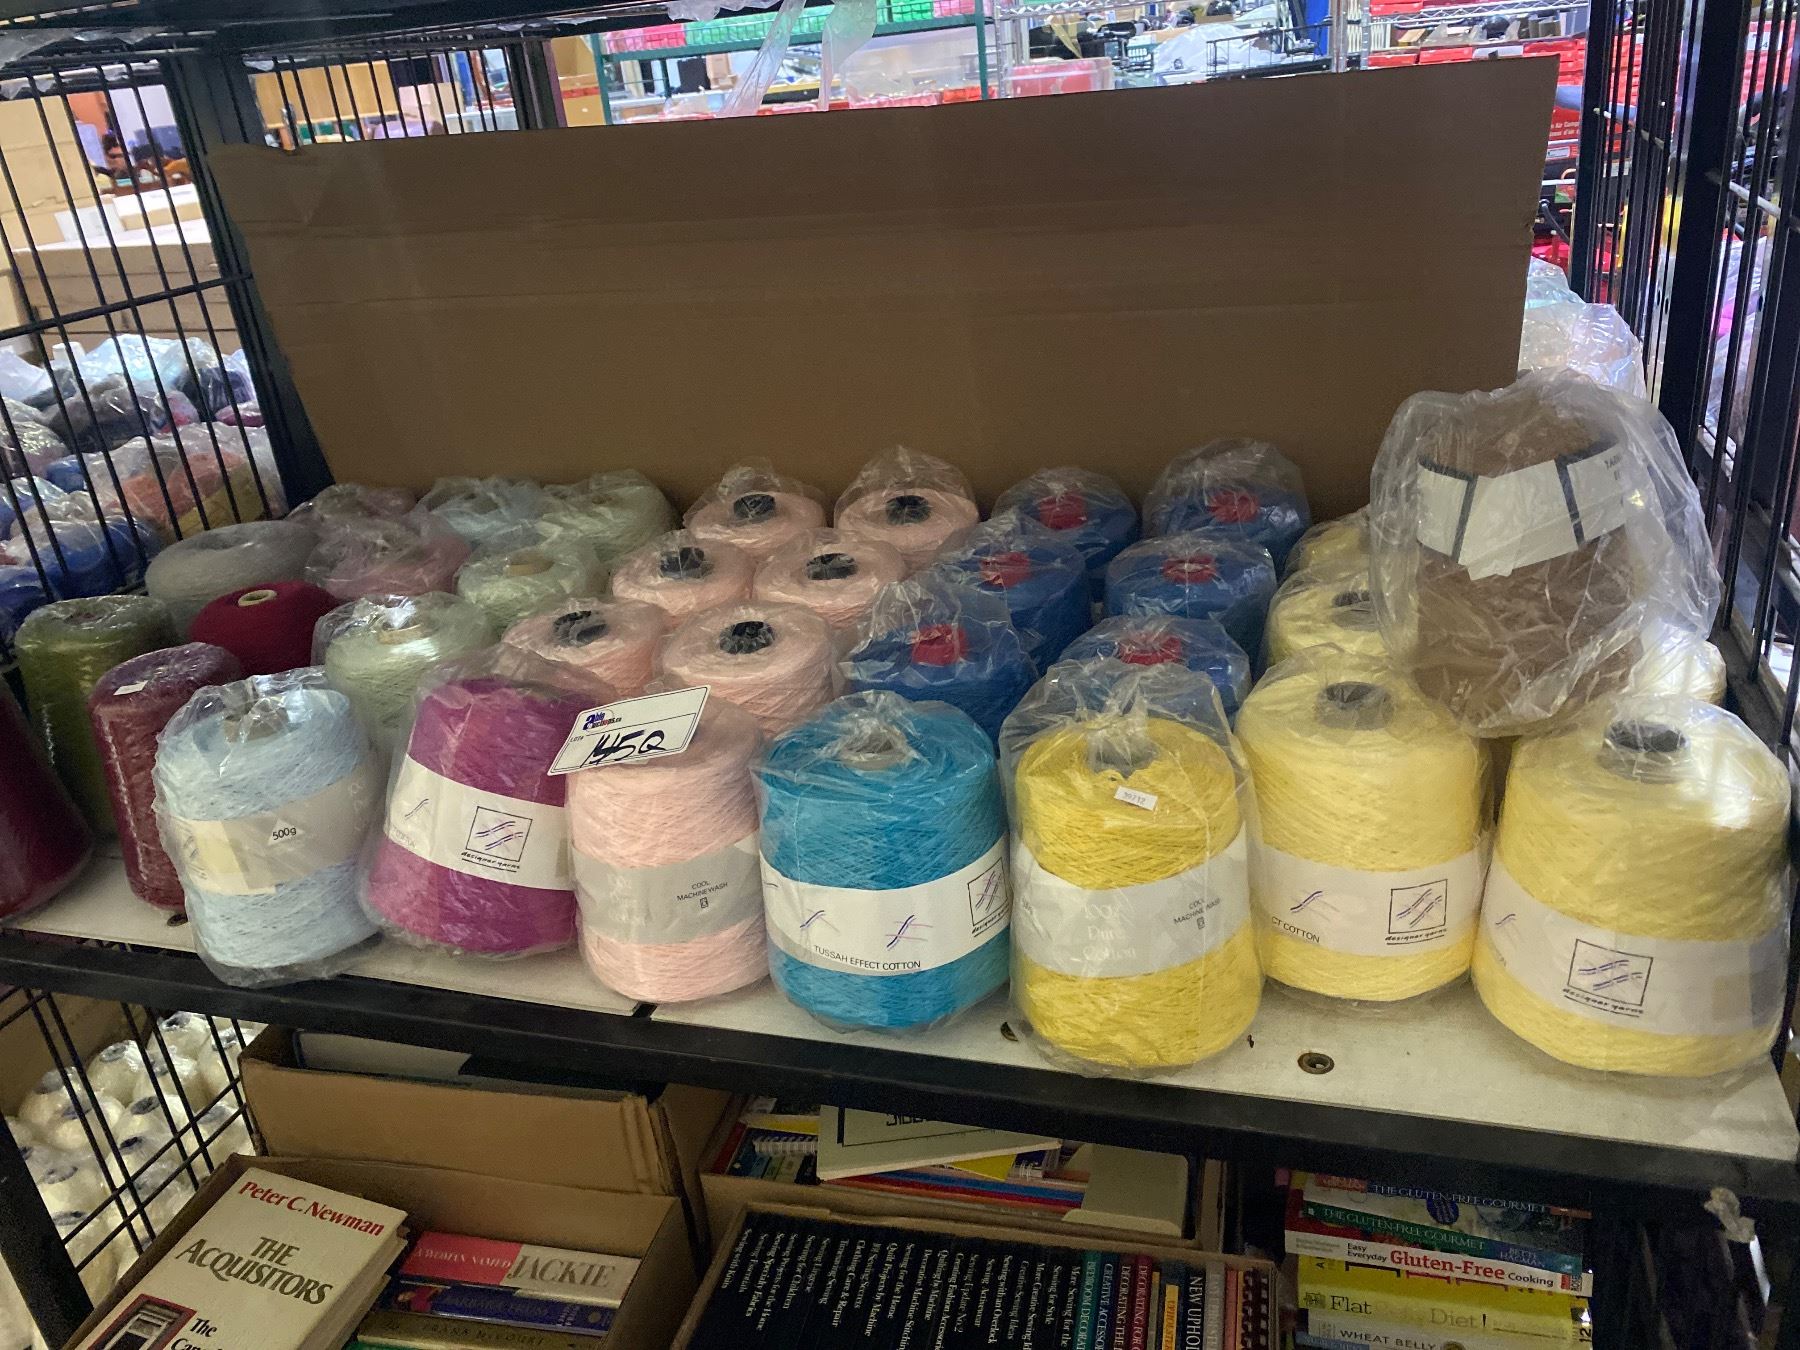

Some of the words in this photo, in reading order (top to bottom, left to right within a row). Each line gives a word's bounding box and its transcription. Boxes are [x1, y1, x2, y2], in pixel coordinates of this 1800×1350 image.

[272, 827, 297, 841] 500g
[676, 887, 709, 901] MACHINE
[708, 882, 728, 895] WASH
[691, 880, 710, 890] COOL
[1282, 922, 1321, 944] COTTON
[814, 945, 849, 963] TUSSAH
[849, 957, 880, 971] EFFECT
[882, 960, 922, 972] COTTON
[238, 1180, 290, 1207] Peter
[286, 1195, 305, 1213] C.
[303, 1200, 386, 1237] Newman
[1372, 1184, 1396, 1196] THE
[1398, 1187, 1479, 1205] GLUTEN-FREE
[1482, 1198, 1546, 1213] GOURMET
[736, 1228, 752, 1253] Sewing
[1324, 1208, 1346, 1221] THE
[1346, 1212, 1420, 1236] GLUTEN-FREE
[1423, 1229, 1485, 1250] GOURMET
[250, 1236, 301, 1268] THE
[767, 1233, 785, 1257] Sewing
[797, 1235, 816, 1264] Sewing
[814, 1237, 830, 1263] Sewing
[847, 1240, 866, 1272] Clothing
[899, 1243, 915, 1269] Sewing
[1347, 1242, 1367, 1252] Easy
[1347, 1250, 1388, 1263] Everyday
[175, 1238, 334, 1305] ACQUISITORS
[506, 1254, 616, 1289] JACKIE
[860, 1253, 878, 1281] Sewing
[877, 1263, 893, 1292] Projects
[898, 1269, 908, 1281] for
[948, 1252, 964, 1283] Creating
[981, 1258, 995, 1284] Sewing
[997, 1255, 1013, 1281] Sewing
[1070, 1266, 1081, 1286] More
[1390, 1250, 1505, 1280] Gluten-Free
[782, 1274, 802, 1309] Children
[843, 1272, 856, 1291] Care
[894, 1282, 905, 1294] the
[997, 1281, 1007, 1298] with
[1048, 1265, 1062, 1293] Sewing
[1082, 1261, 1096, 1306] BEDROOM
[1100, 1263, 1113, 1305] CREATIVE
[1189, 1276, 1203, 1305] NEW
[1508, 1272, 1555, 1288] Cooking
[745, 1291, 762, 1317] Fabrics
[887, 1295, 901, 1318] Home
[907, 1287, 923, 1319] Machine
[924, 1290, 940, 1321] Machine
[944, 1284, 958, 1312] Fashion
[974, 1287, 989, 1327] Activewear
[1029, 1282, 1042, 1312] Creative
[1048, 1294, 1058, 1305] for
[1062, 1288, 1077, 1317] Sewing
[1116, 1266, 1131, 1324] DECORATING
[1134, 1265, 1148, 1324] DECORATING
[1330, 1294, 1373, 1315] Flat
[832, 1300, 848, 1327] Repair
[865, 1304, 882, 1337] Machine
[988, 1308, 1002, 1344] Overlock
[1021, 1313, 1037, 1341] Sewing
[1045, 1306, 1055, 1325] Style
[1063, 1319, 1074, 1331] for
[189, 1317, 218, 1338] The
[898, 1320, 914, 1350] Stitchin
[1060, 1333, 1072, 1347] the
[1114, 1326, 1125, 1345] THE
[1132, 1326, 1143, 1345] FOR
[1340, 1329, 1391, 1345] WHEAT
[1395, 1337, 1437, 1350] BELLY
